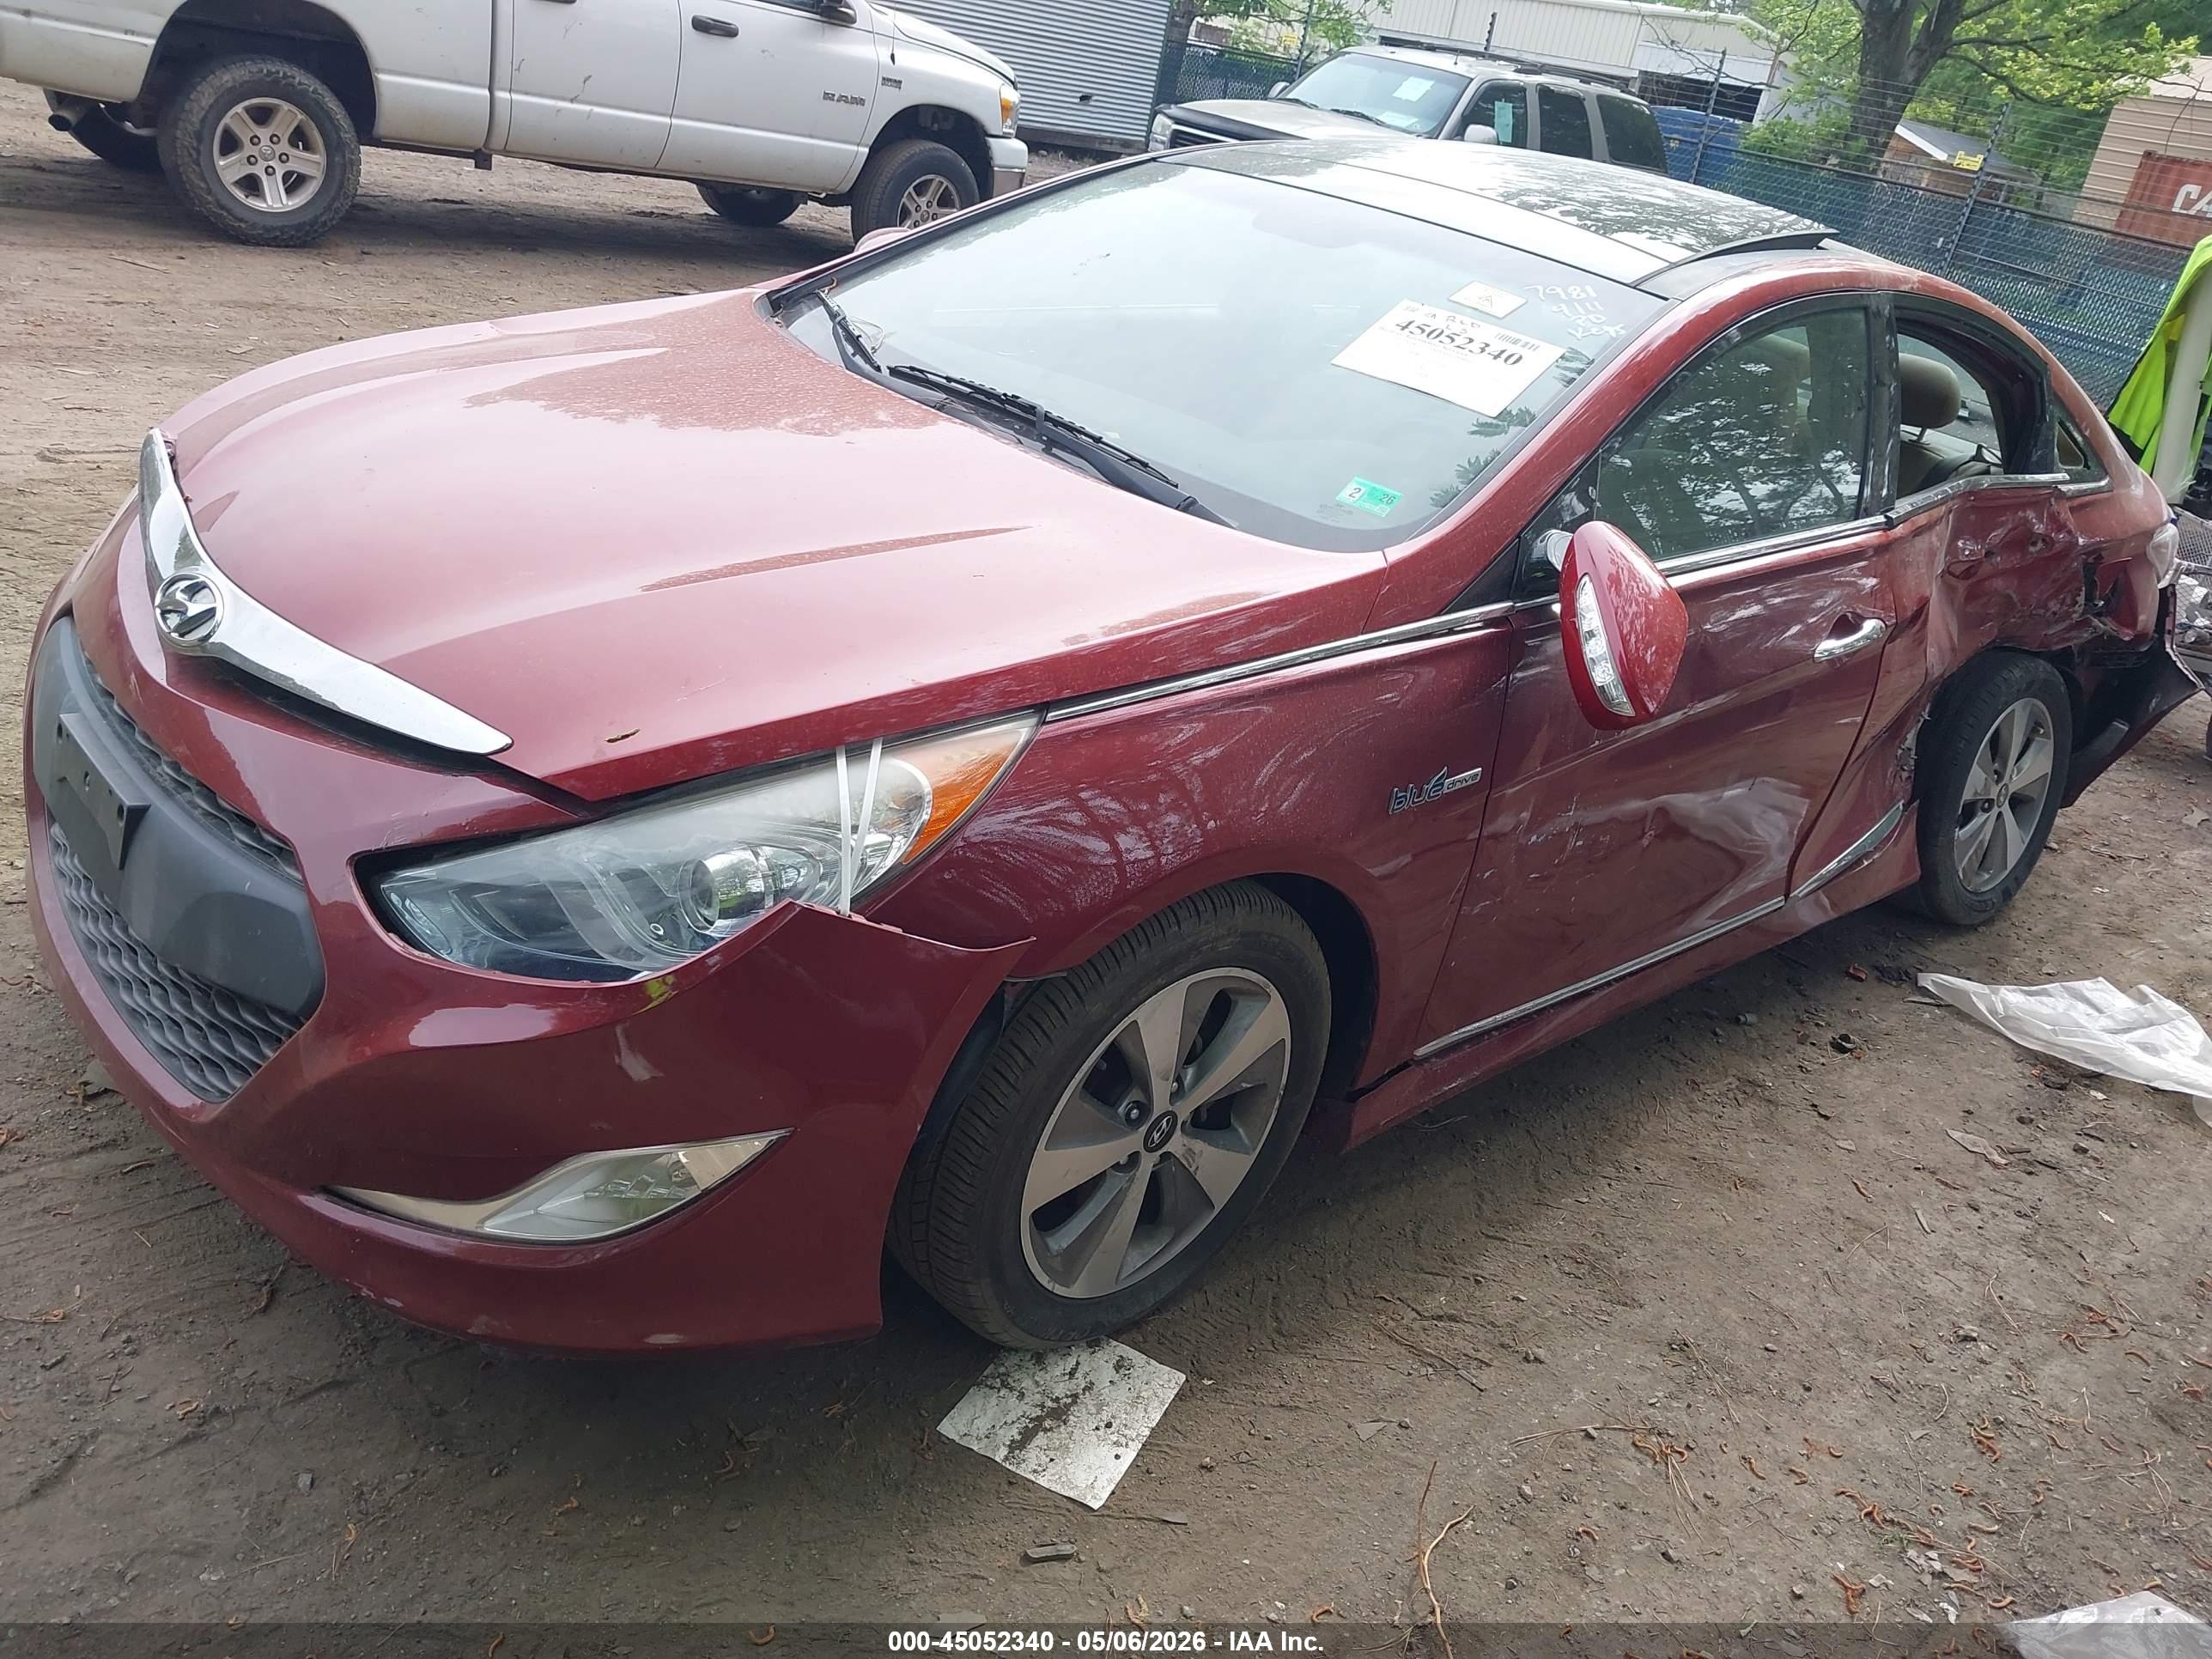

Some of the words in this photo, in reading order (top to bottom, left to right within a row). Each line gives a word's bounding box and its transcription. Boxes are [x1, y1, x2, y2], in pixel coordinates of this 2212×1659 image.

[823, 89, 866, 106] RAM
[1524, 285, 1598, 301] 7981
[1395, 319, 1523, 366] 45052340
[1348, 487, 1362, 499] 2
[1379, 493, 1396, 505] 26
[1389, 766, 1448, 815] blue
[1446, 774, 1479, 790] drive
